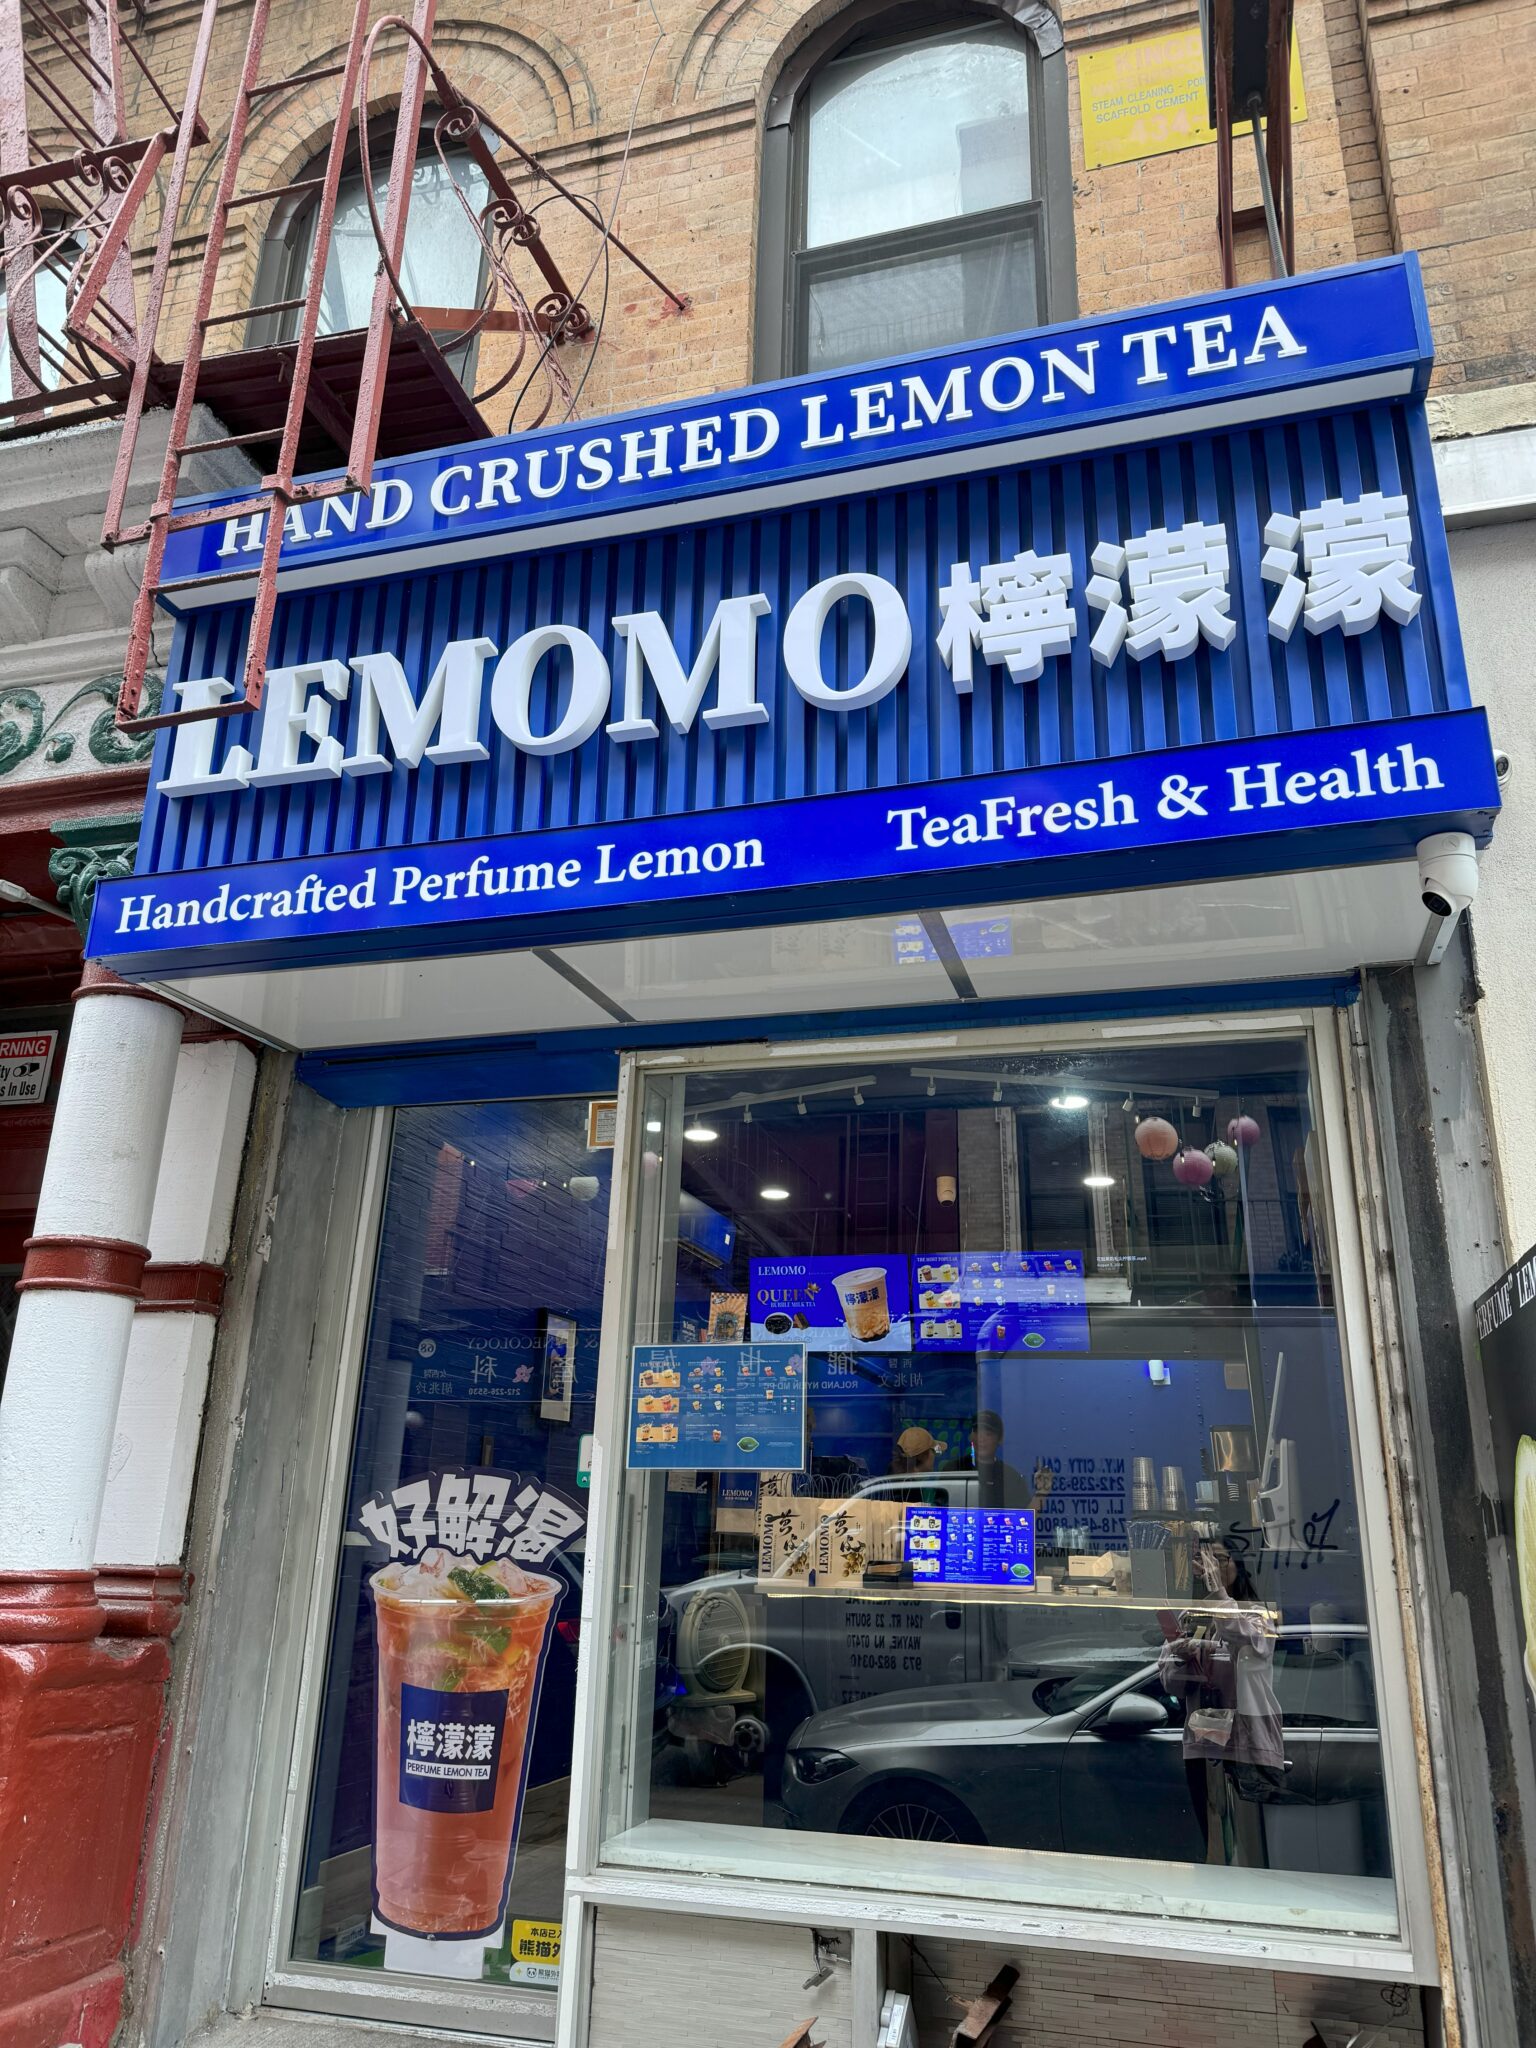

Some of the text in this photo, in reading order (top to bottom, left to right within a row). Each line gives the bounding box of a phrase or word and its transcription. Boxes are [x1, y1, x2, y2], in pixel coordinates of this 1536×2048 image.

[1092, 96, 1123, 112] STEAM
[1127, 84, 1174, 103] CLEANING
[1096, 91, 1199, 124] SCAFFOLD CEMENT
[217, 305, 1306, 556] HAND CRUSHED LEMON TEA
[936, 491, 1422, 694] 檸濛濛
[156, 572, 911, 798] LEMOMO
[114, 867, 377, 933] Handcrafted
[389, 853, 583, 907] Perfume
[594, 842, 764, 886] Lemon
[1156, 774, 1210, 818] &
[1225, 742, 1445, 812] Health
[8, 1082, 17, 1096] In
[19, 1081, 36, 1096] Use
[758, 1265, 806, 1276] LEMOMO
[757, 1288, 815, 1305] QUEEN
[722, 1489, 753, 1497] LEMOMO
[359, 1473, 586, 1562] 好解渴
[762, 1513, 774, 1573] LEMOMO
[819, 1515, 830, 1574] LEMOMO
[407, 1719, 496, 1760] 檸濛濛
[407, 1762, 488, 1778] PERFUME LEMON TEA
